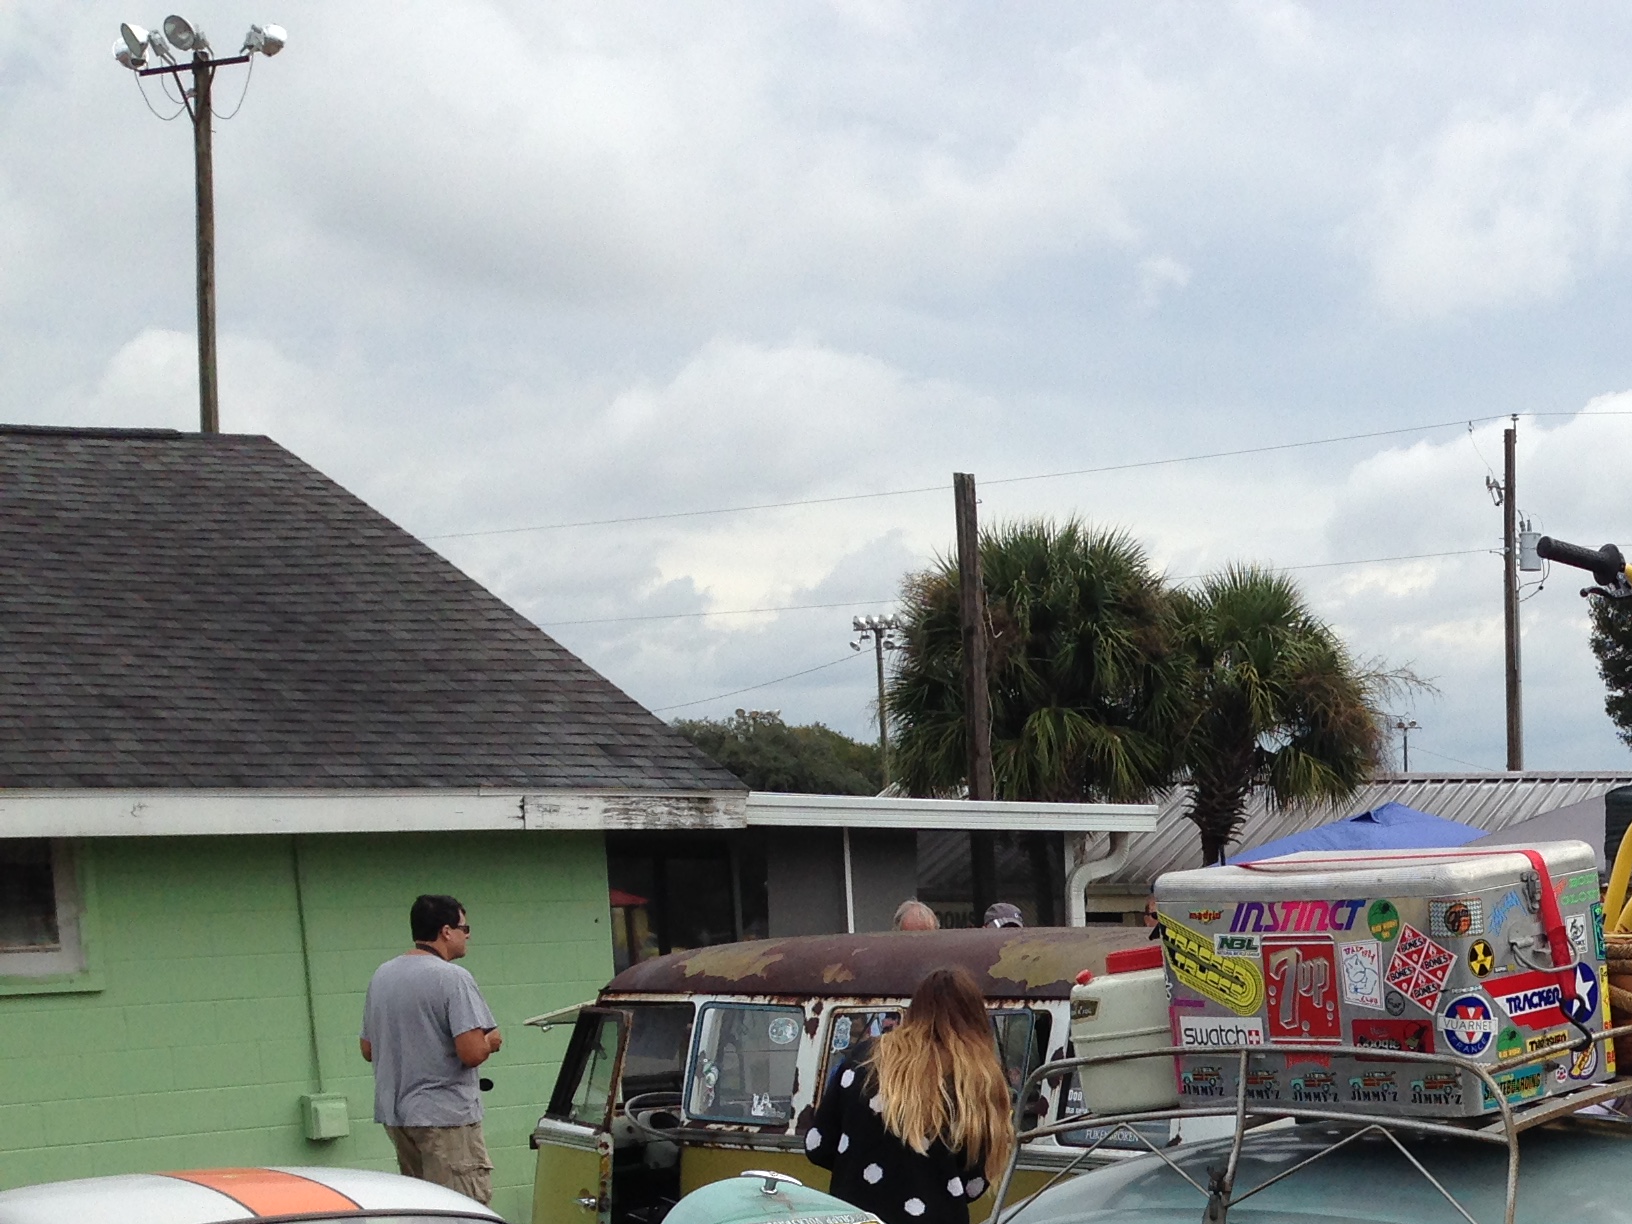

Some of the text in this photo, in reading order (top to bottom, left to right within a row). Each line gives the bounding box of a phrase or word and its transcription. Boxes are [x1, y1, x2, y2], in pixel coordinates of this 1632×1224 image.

[1229, 900, 1366, 933] INSTINCT
[1217, 935, 1260, 951] NBL
[1400, 937, 1424, 953] BONES
[1424, 954, 1448, 970] BONES
[1390, 966, 1413, 982] BONES
[1413, 983, 1438, 999] BONES
[1506, 986, 1561, 1015] TRACKER
[1442, 1018, 1494, 1032] VUARNET
[1184, 1025, 1247, 1046] swatch
[1450, 1035, 1488, 1053] FRANCE
[1292, 1091, 1340, 1103] JIMMY'Z
[1351, 1090, 1398, 1102] JIMMY'Z
[1411, 1093, 1462, 1105] JIMMY'Z
